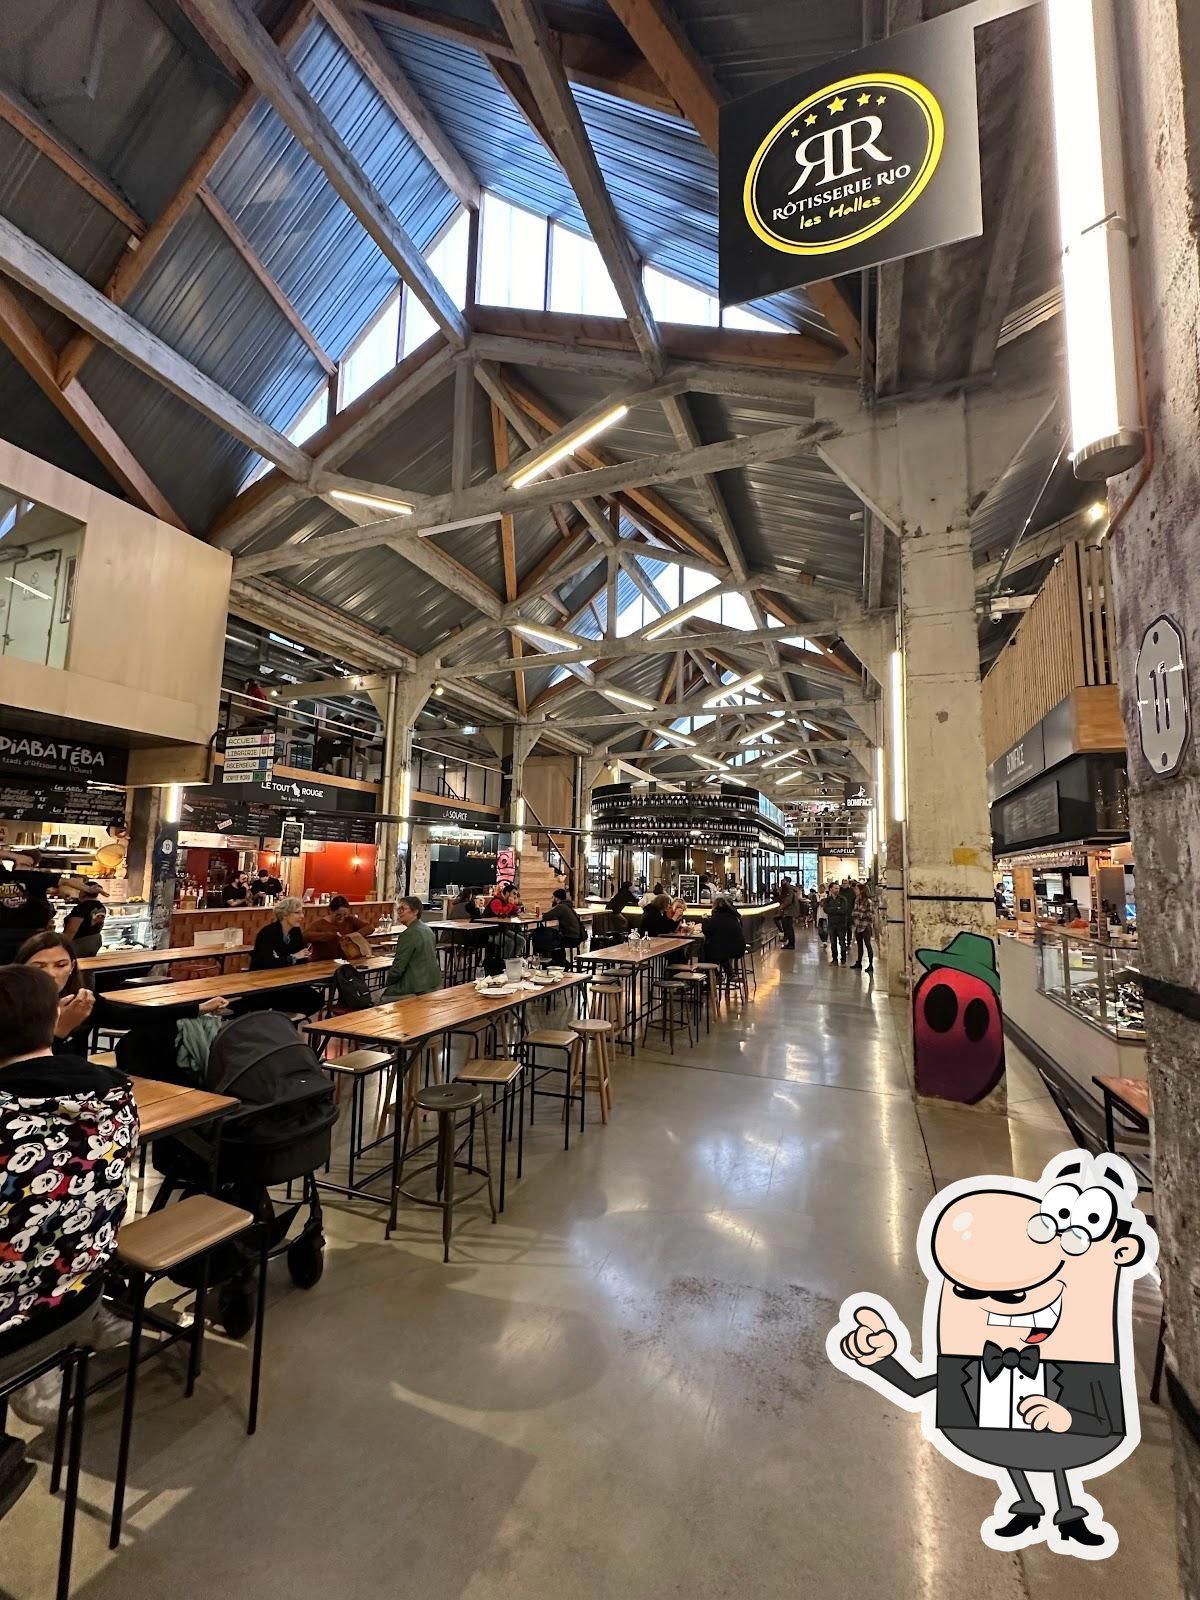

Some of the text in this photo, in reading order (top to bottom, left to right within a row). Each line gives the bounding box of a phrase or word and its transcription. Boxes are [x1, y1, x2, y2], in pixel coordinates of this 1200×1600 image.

[772, 164, 912, 221] RÔTISSERIE RIO
[799, 196, 882, 230] les Halles
[228, 737, 258, 745] ACCUEIL
[227, 749, 258, 757] LIBRAIRIE
[226, 761, 257, 769] ASCENSEUR
[261, 782, 324, 798] LE TOUT ROUGE
[846, 798, 873, 807] BONIFACE
[449, 811, 468, 821] SOURCE
